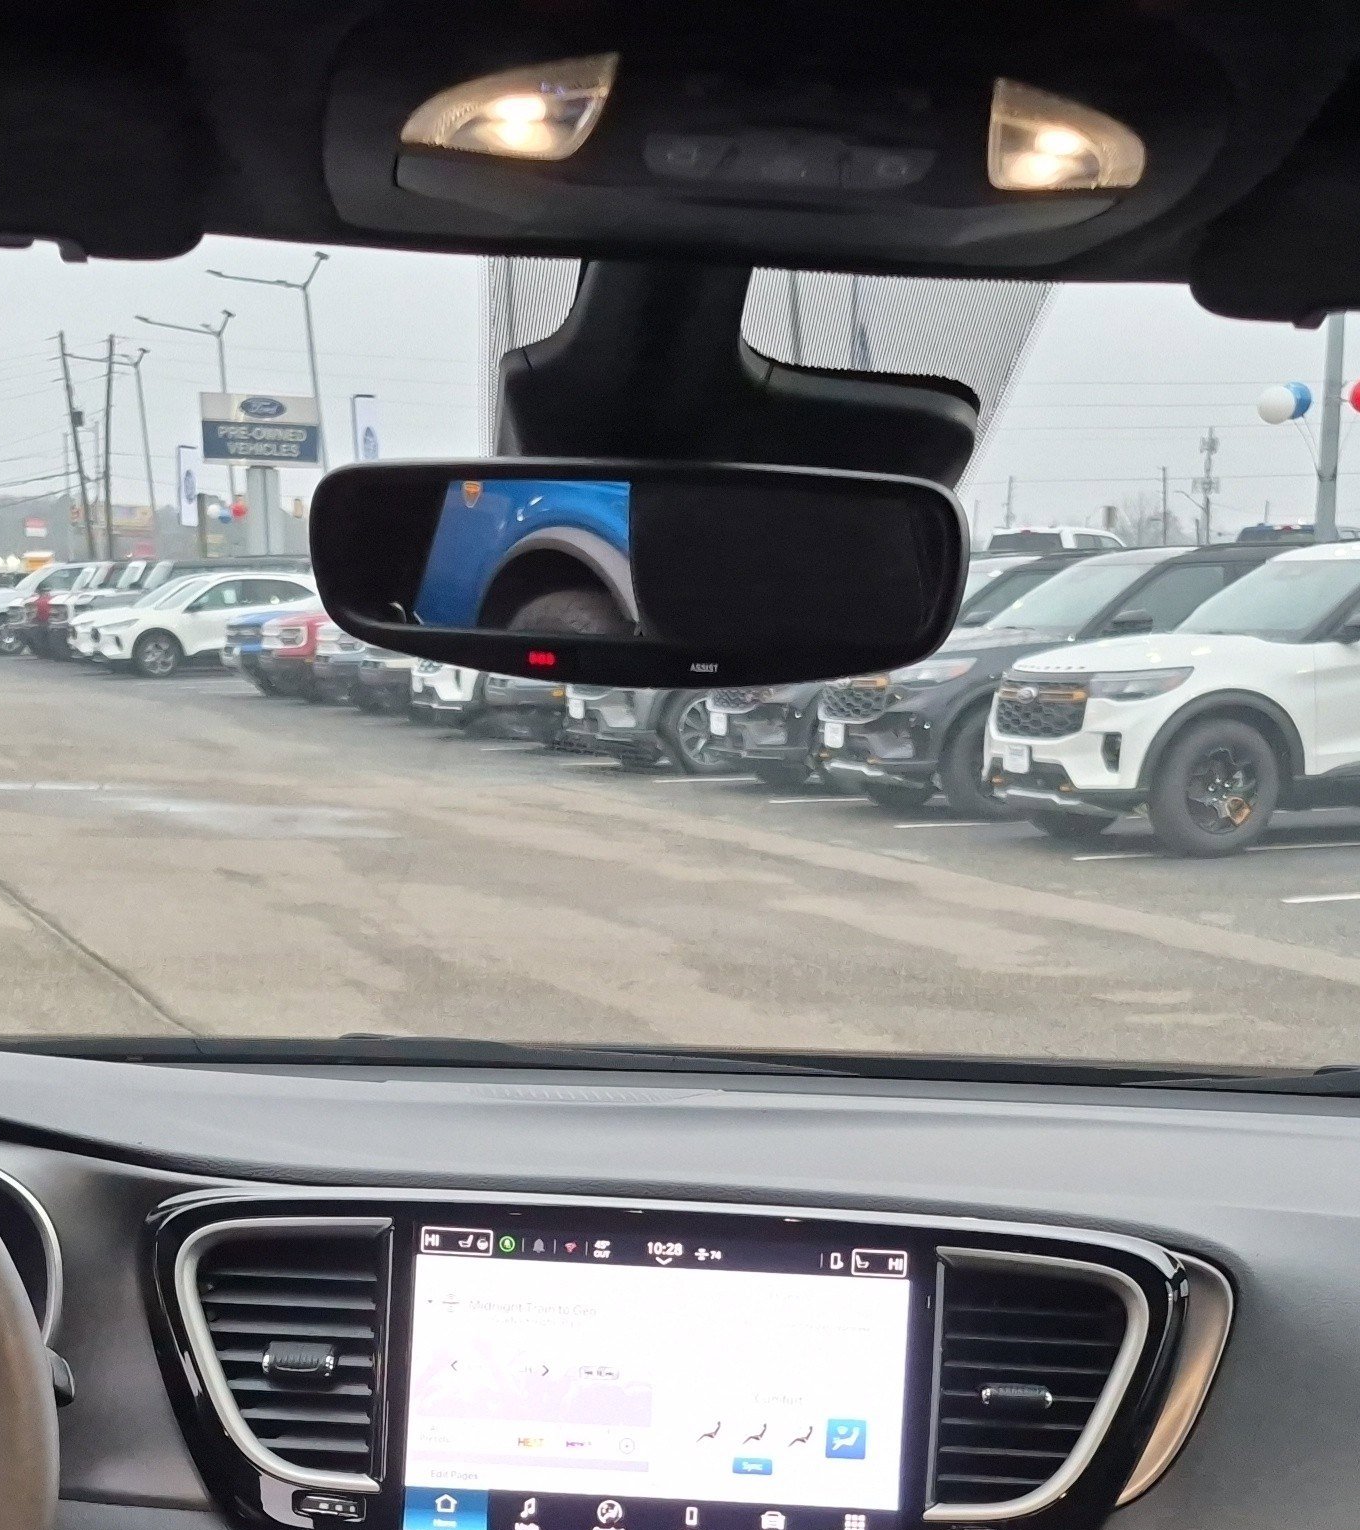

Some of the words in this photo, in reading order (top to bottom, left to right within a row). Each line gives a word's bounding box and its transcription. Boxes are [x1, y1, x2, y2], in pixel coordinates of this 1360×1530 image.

[218, 426, 307, 441] PRE-OWNED
[227, 441, 300, 457] VEHICLES
[690, 663, 728, 672] ASSIST
[425, 1234, 440, 1247] HI
[647, 1241, 683, 1256] 10:28
[888, 1257, 904, 1271] HI
